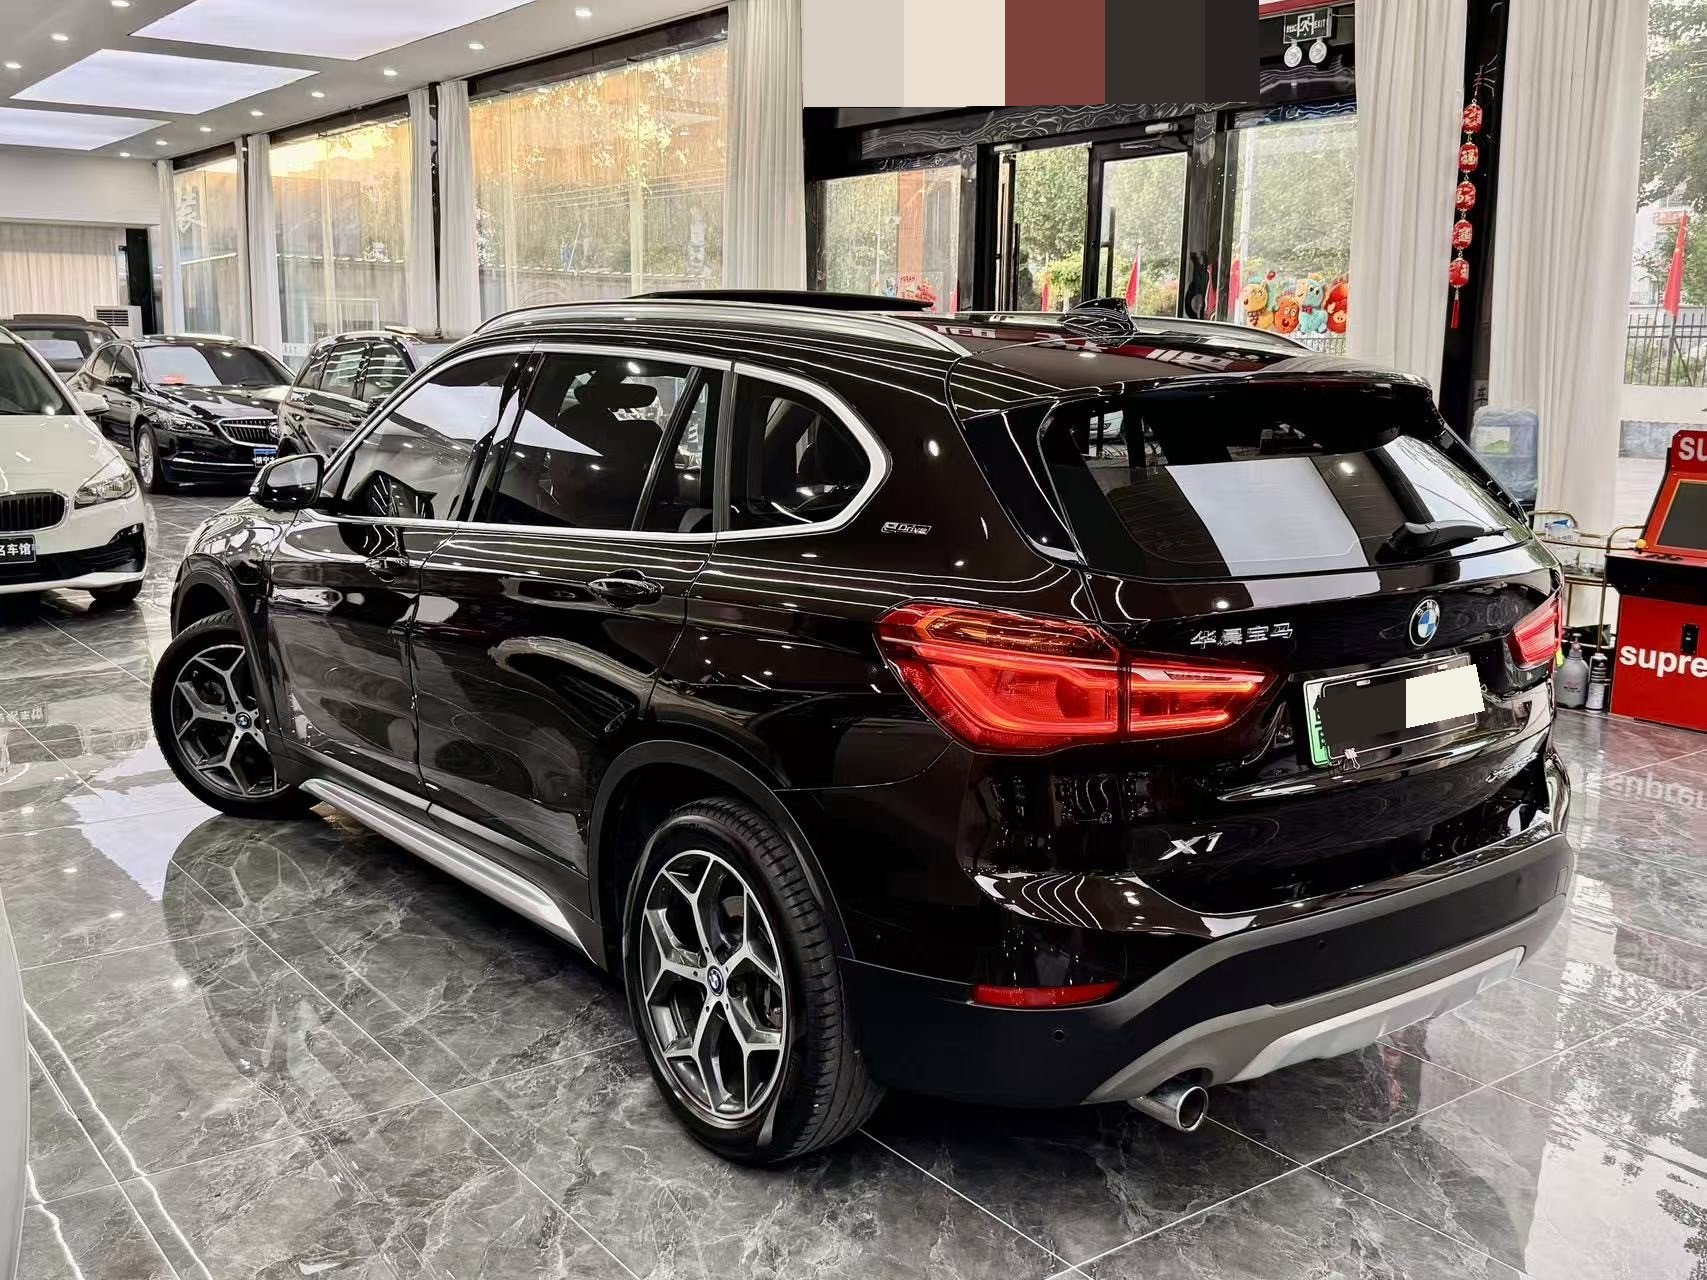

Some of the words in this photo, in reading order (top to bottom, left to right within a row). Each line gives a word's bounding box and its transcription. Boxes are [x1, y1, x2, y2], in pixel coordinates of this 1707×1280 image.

[1190, 622, 1294, 649] 华晨宝马
[1619, 645, 1707, 678] supre
[1158, 832, 1223, 861] X1
